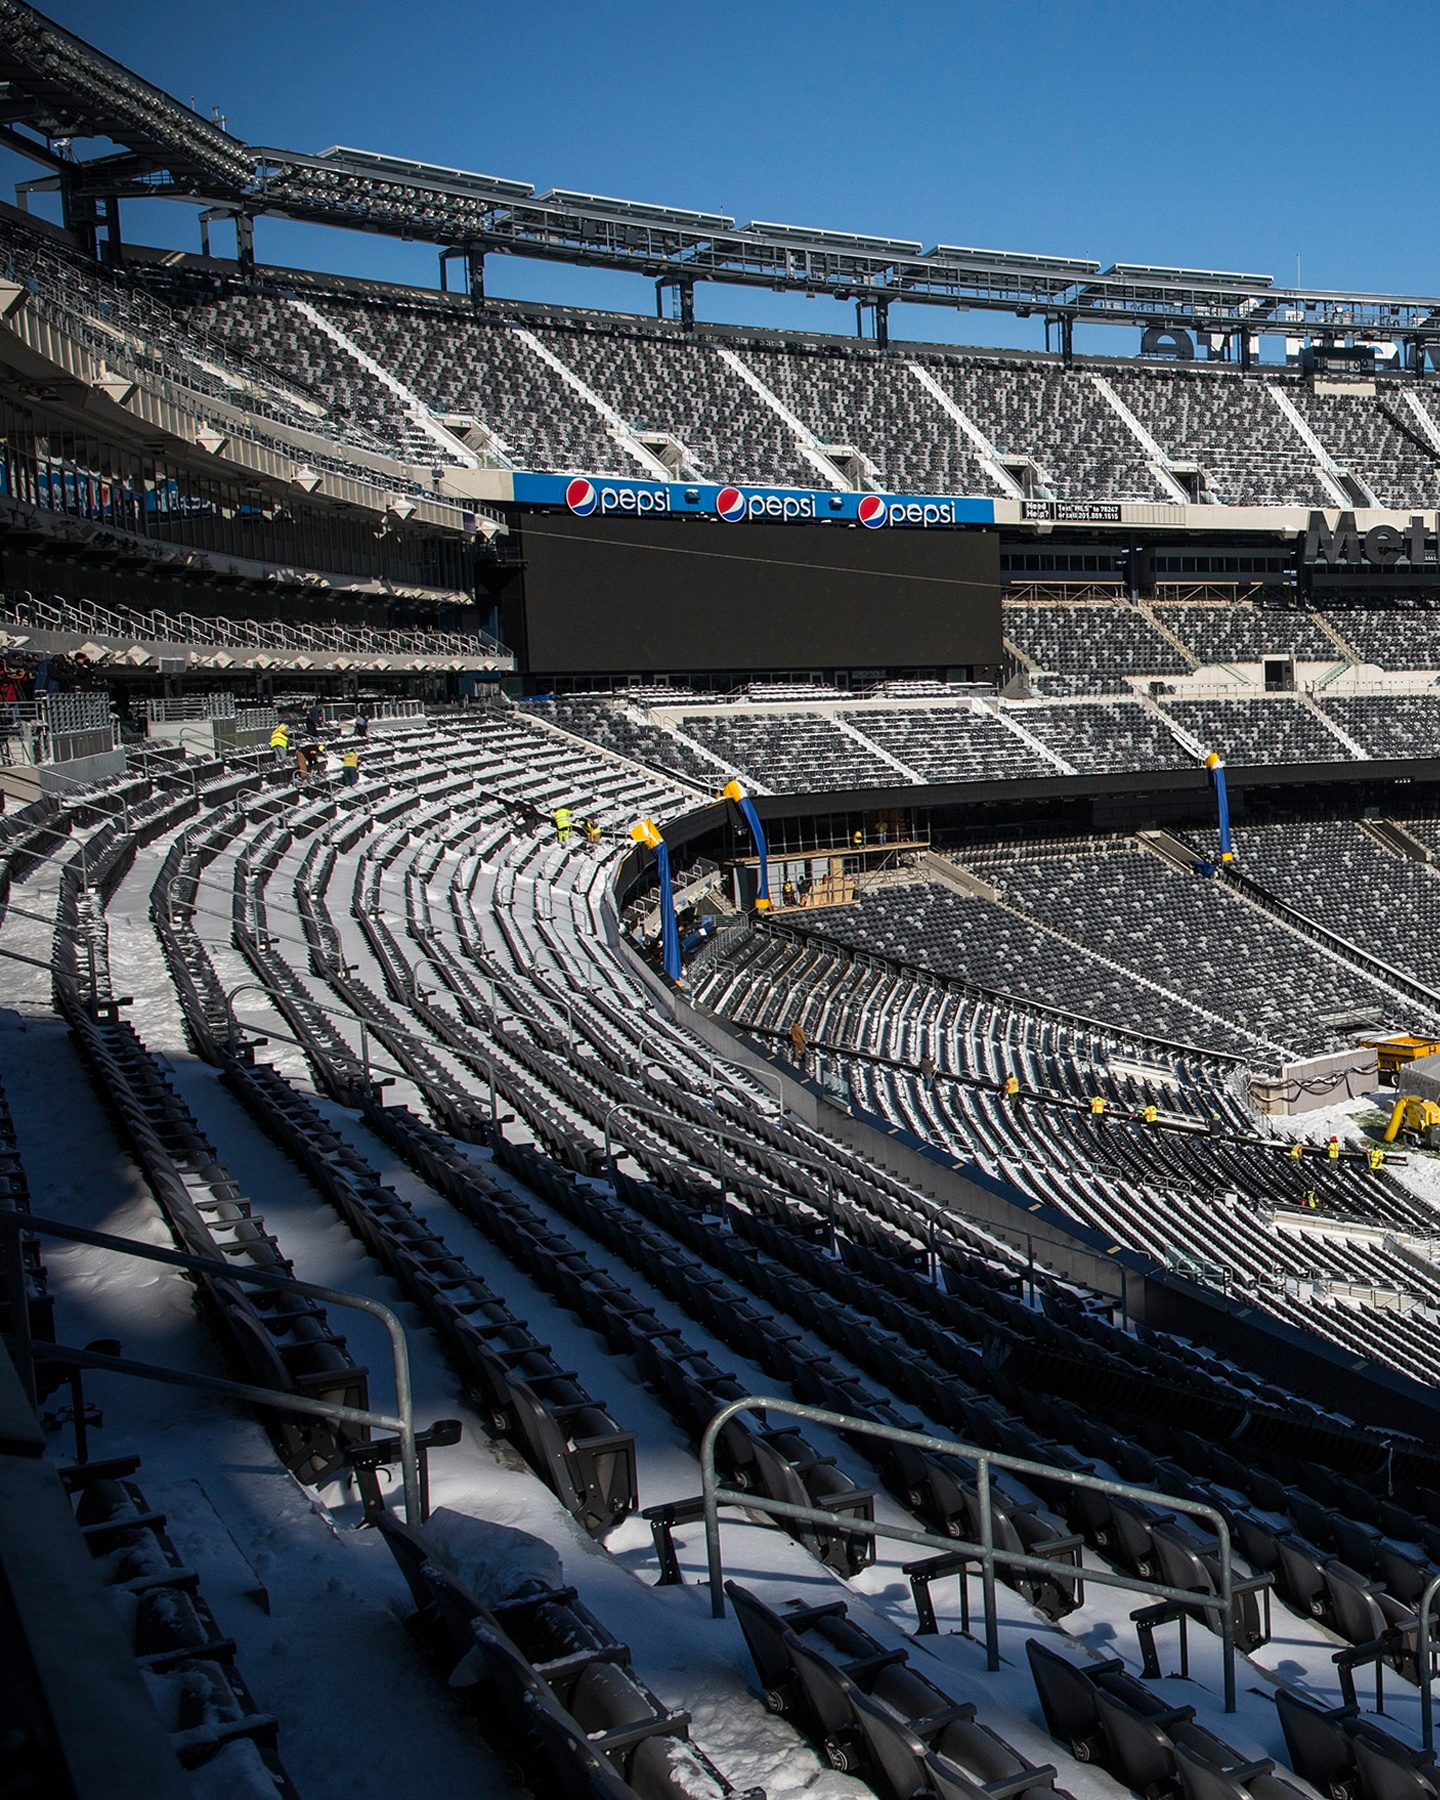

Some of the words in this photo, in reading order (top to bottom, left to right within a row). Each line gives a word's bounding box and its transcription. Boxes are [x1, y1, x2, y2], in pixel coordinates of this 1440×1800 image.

[602, 488, 671, 514] pepsi
[748, 494, 815, 522] pepsi
[889, 501, 956, 527] pepsi
[1026, 502, 1047, 510] Need
[1026, 510, 1049, 519] Help?
